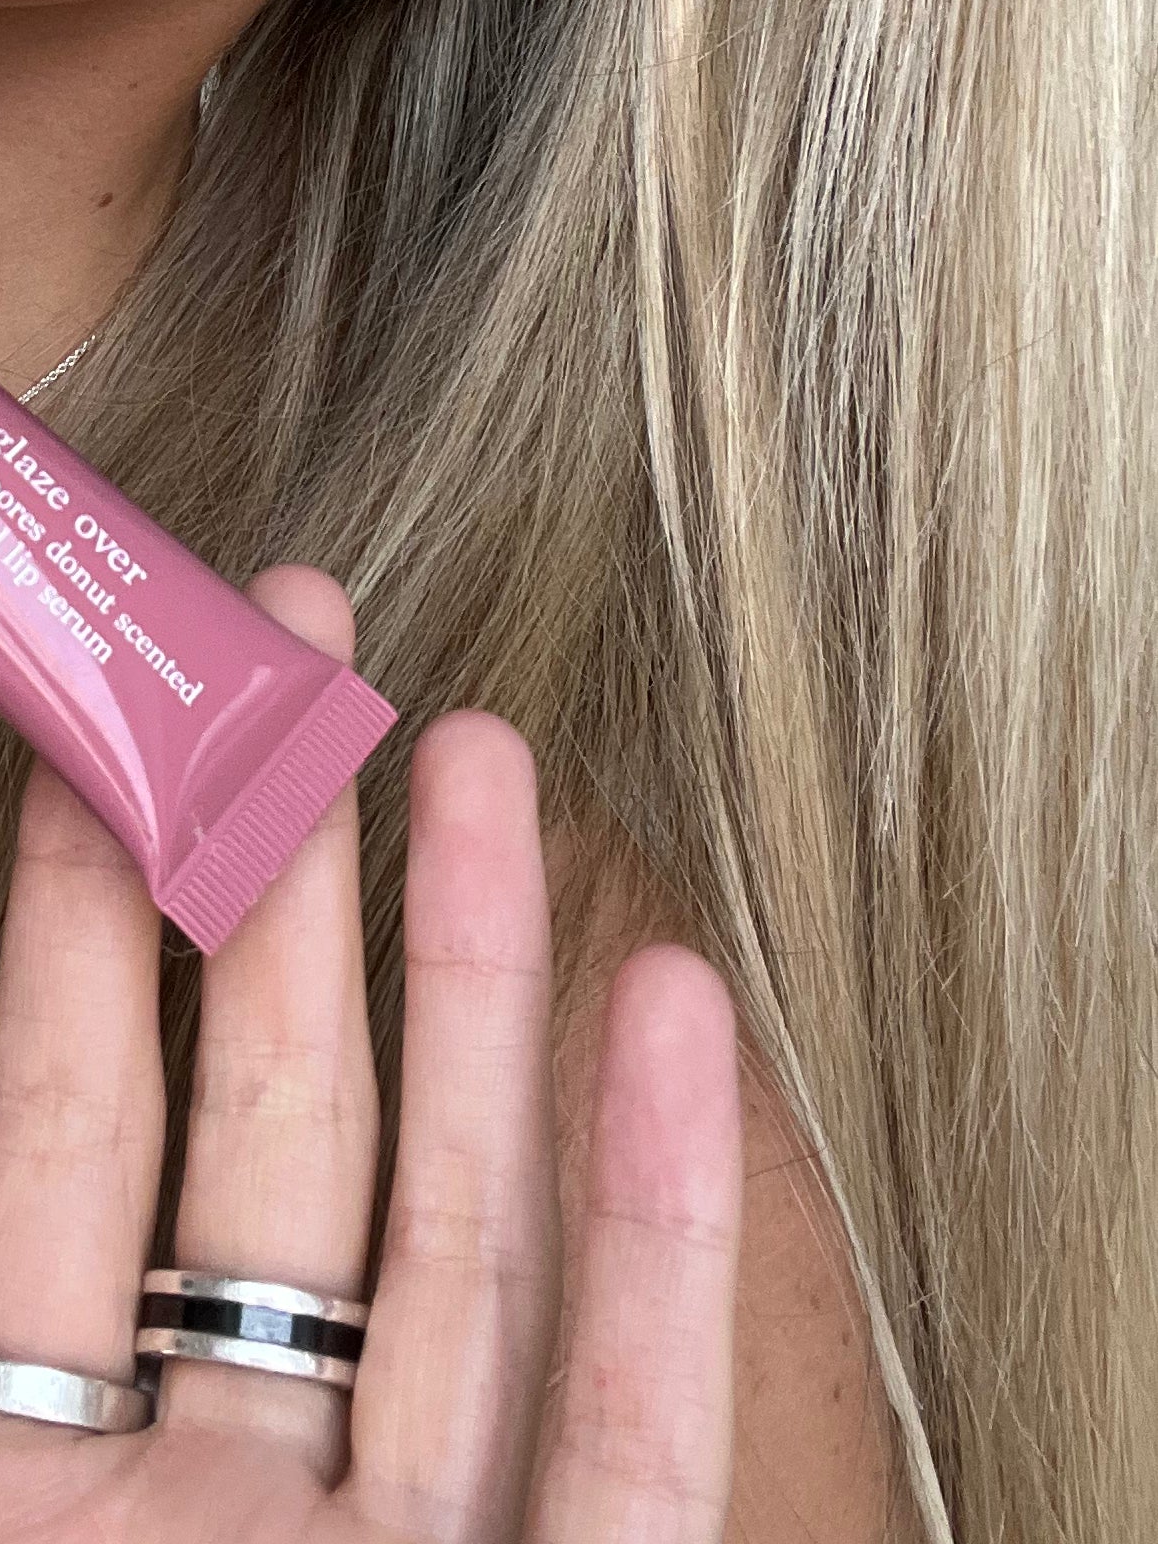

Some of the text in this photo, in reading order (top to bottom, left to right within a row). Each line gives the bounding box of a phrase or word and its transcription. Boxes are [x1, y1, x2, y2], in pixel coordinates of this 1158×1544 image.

[1, 540, 40, 587] lip
[37, 584, 113, 664] serum
[74, 514, 147, 585] over
[45, 540, 117, 614] donut
[113, 613, 204, 706] scented
